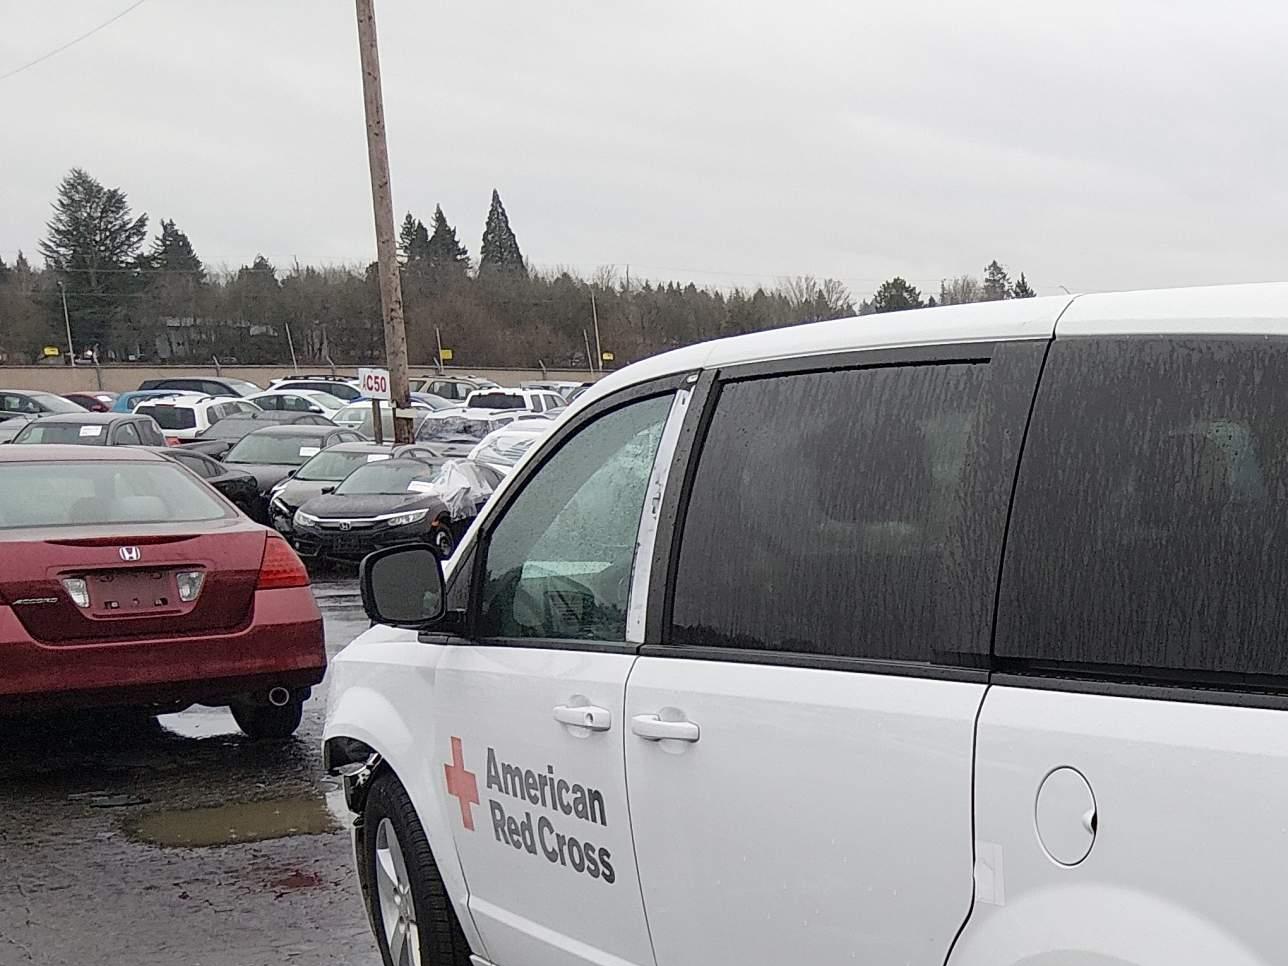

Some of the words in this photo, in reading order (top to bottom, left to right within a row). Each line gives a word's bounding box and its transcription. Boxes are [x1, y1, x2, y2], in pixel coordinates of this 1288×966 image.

[486, 747, 607, 827] American
[488, 799, 538, 856] Red
[537, 816, 616, 885] Cross
